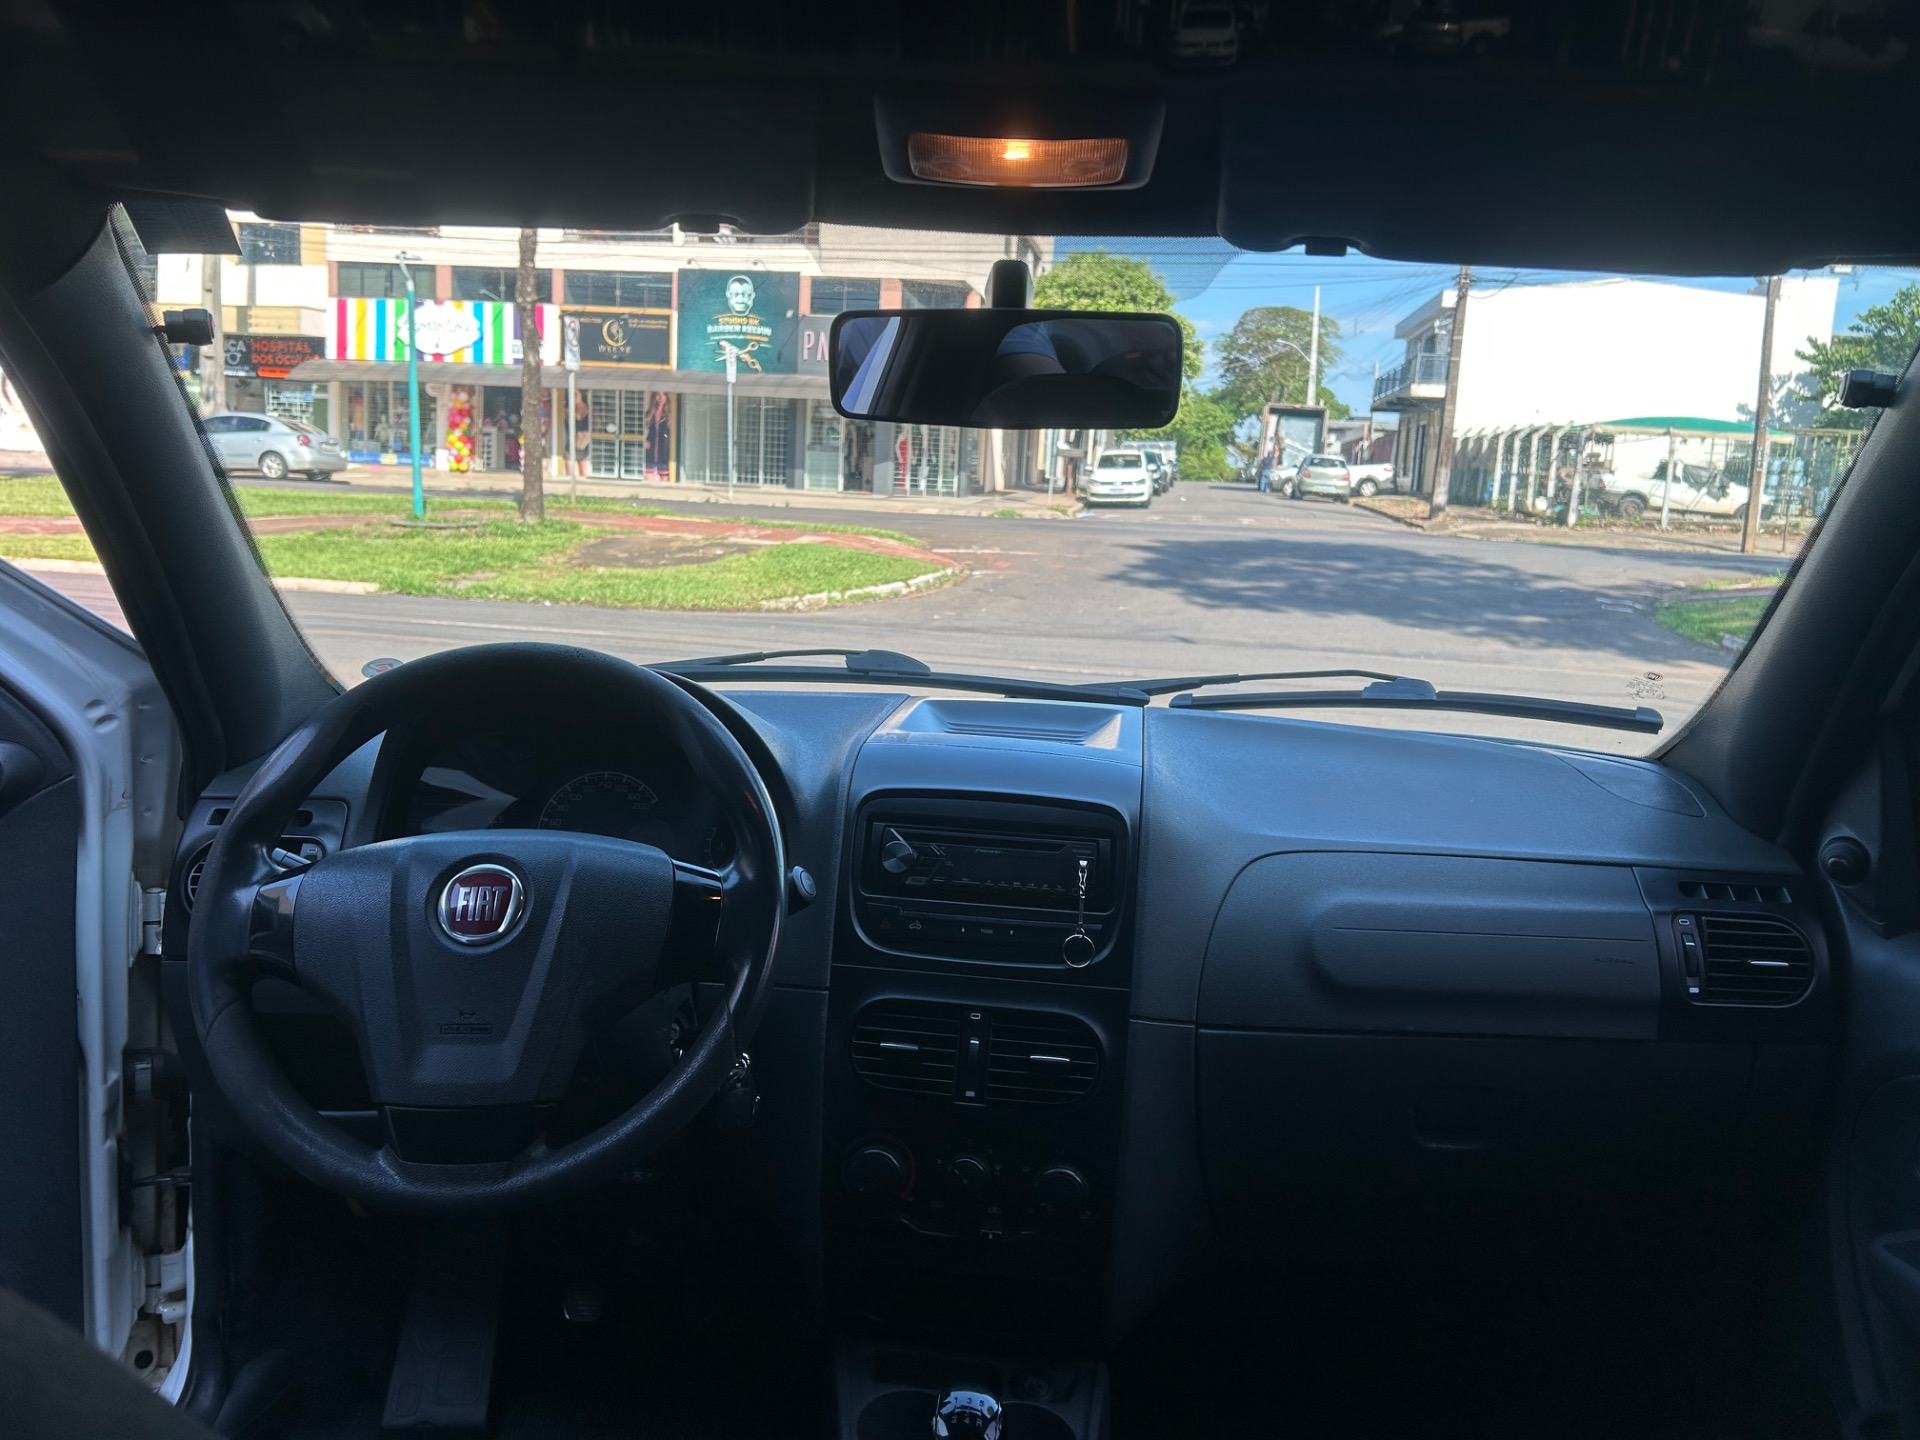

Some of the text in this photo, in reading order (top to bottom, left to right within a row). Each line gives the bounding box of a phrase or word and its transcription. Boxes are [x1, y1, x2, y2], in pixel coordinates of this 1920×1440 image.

[251, 340, 311, 353] HOSPITAL
[802, 330, 829, 361] PA
[251, 353, 274, 364] DOS
[455, 886, 508, 922] FIAT
[963, 1416, 970, 1425] 4
[976, 1419, 983, 1428] R
